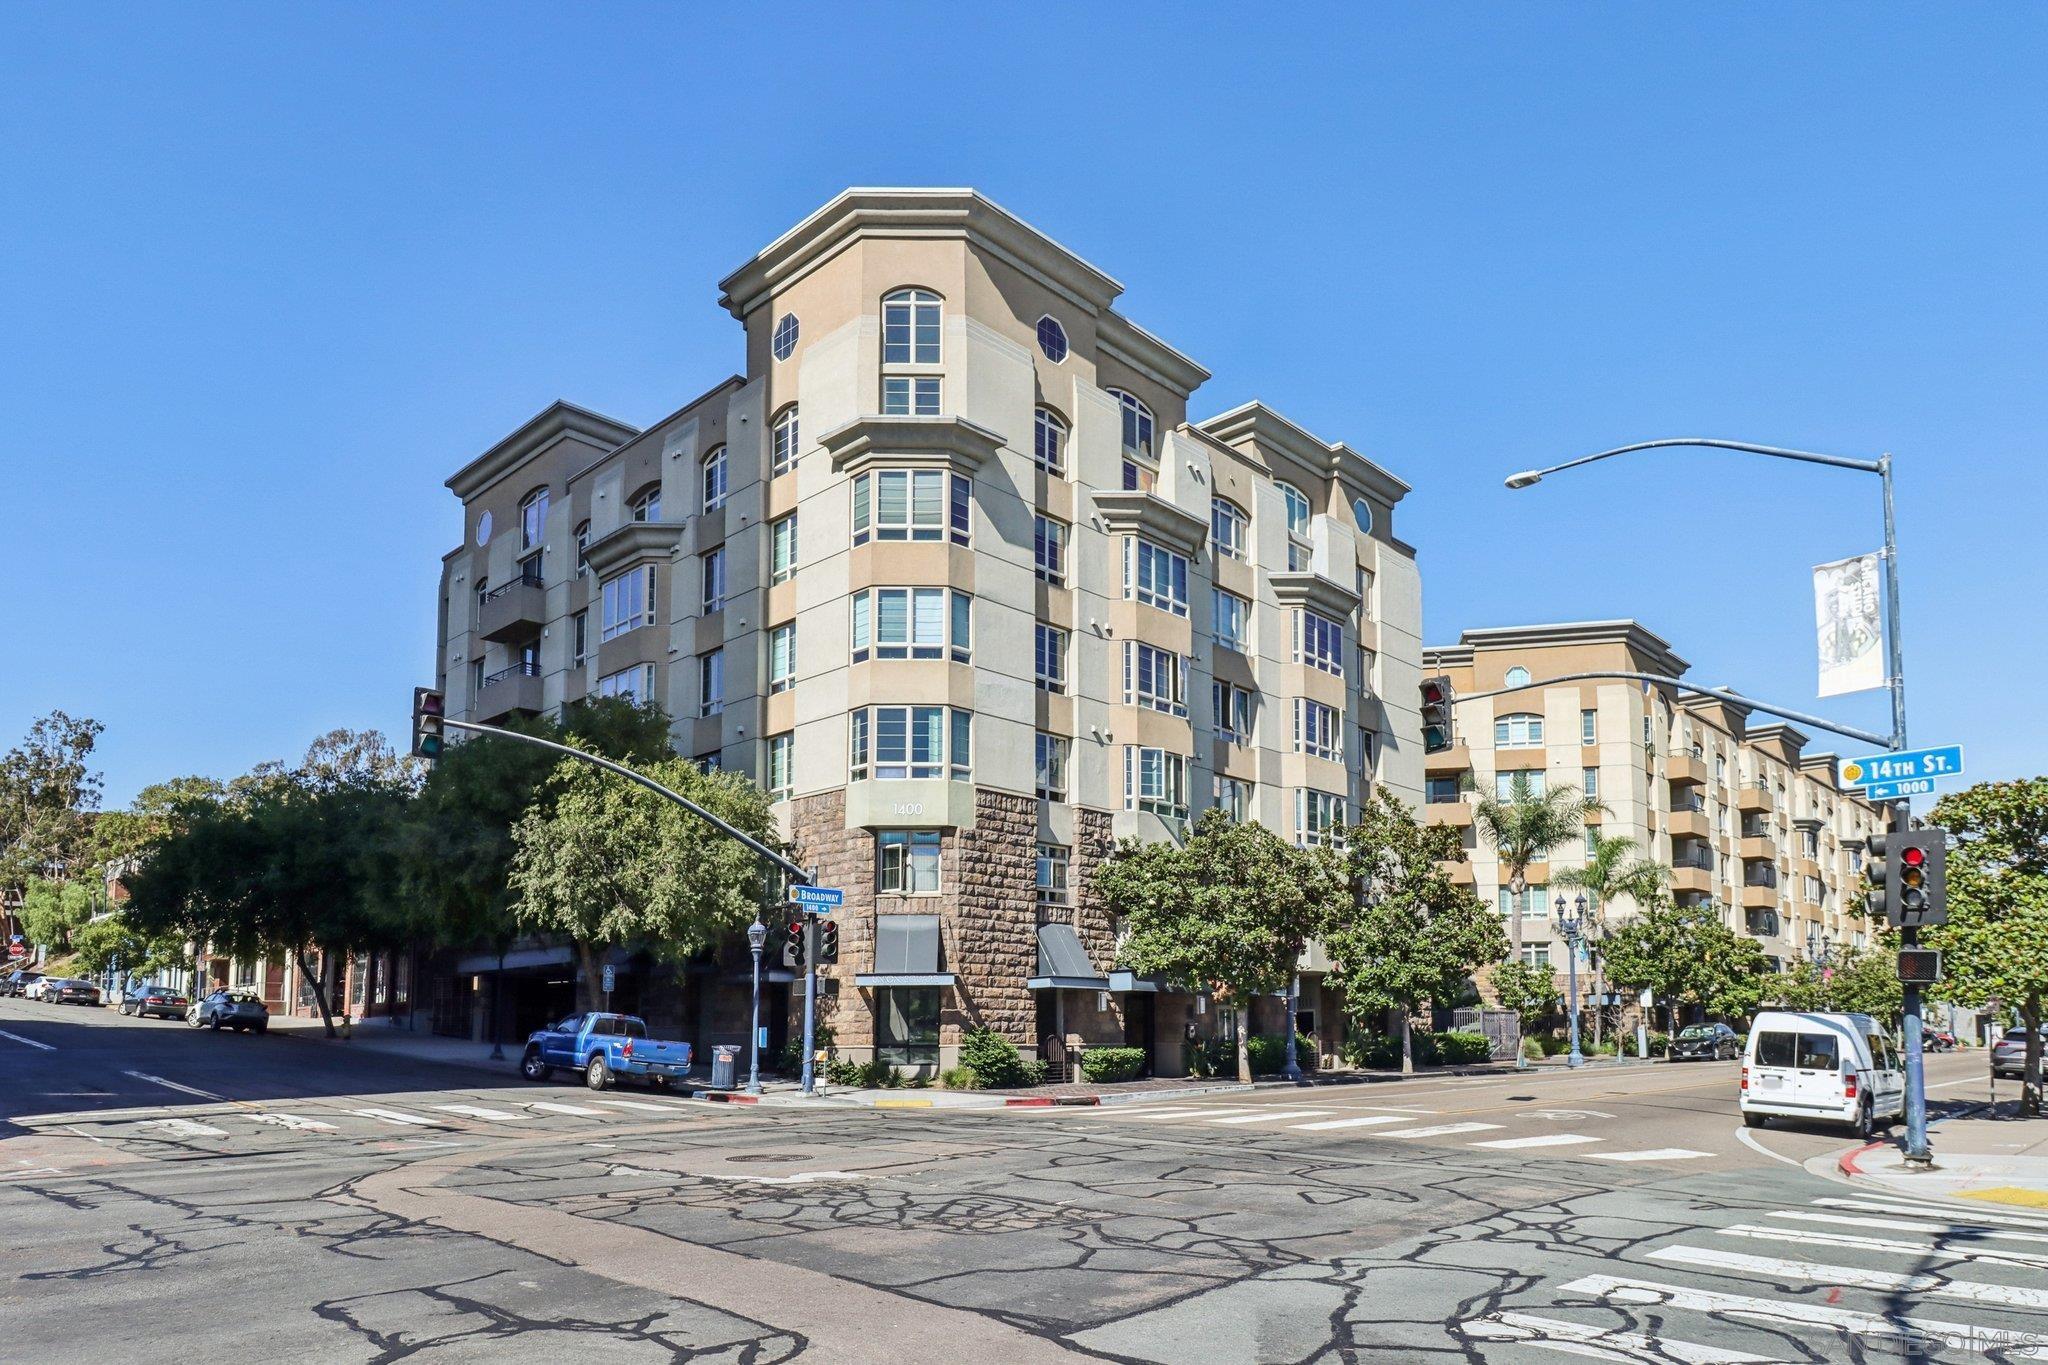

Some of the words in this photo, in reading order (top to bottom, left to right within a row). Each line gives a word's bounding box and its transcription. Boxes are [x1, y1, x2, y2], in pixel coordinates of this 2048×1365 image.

[1870, 760, 1915, 779] 14TH
[1896, 780, 1929, 795] 1000
[893, 802, 923, 815] 1400
[801, 890, 839, 903] BROADWAY
[806, 904, 819, 912] 1400
